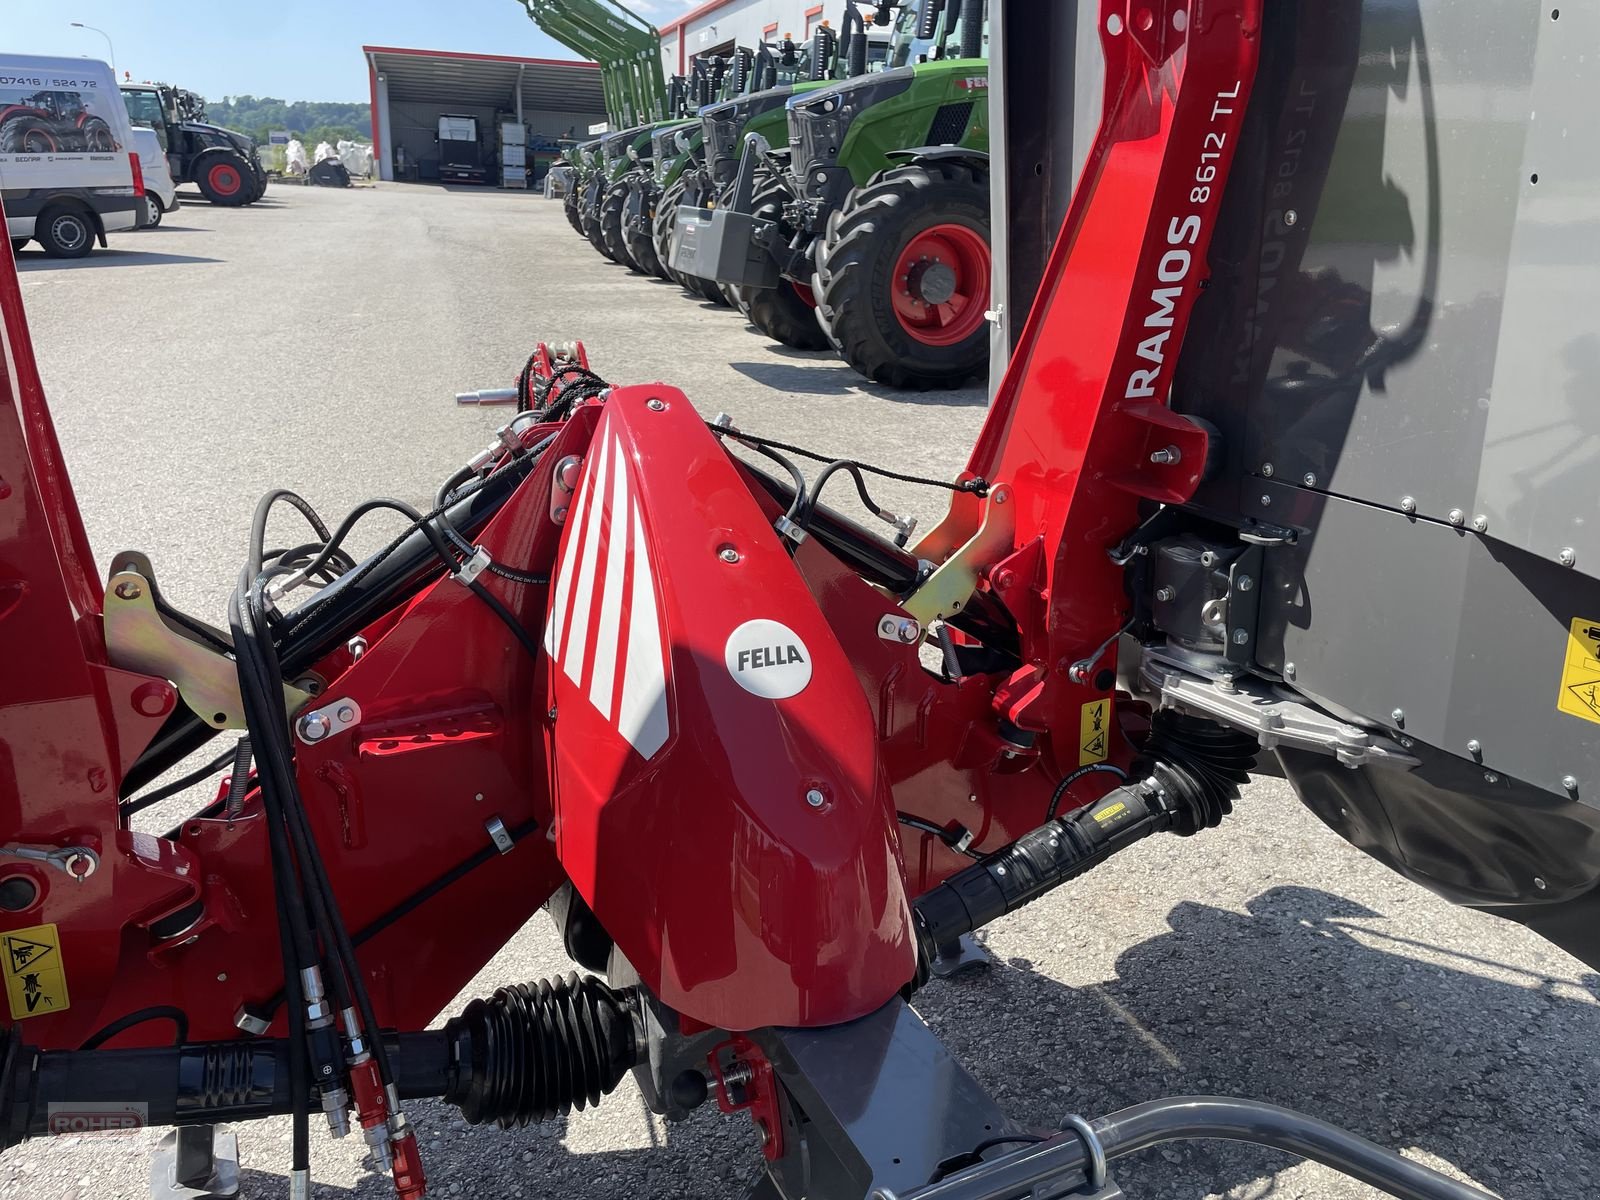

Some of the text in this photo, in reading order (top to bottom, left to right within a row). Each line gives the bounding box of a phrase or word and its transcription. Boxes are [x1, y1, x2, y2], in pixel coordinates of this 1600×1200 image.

[0, 77, 40, 86] 07416
[52, 79, 77, 87] 524
[80, 80, 97, 88] 72
[965, 77, 988, 88] FEN
[1124, 80, 1241, 399] RAMOS 8612 TL
[737, 644, 805, 672] FELLA
